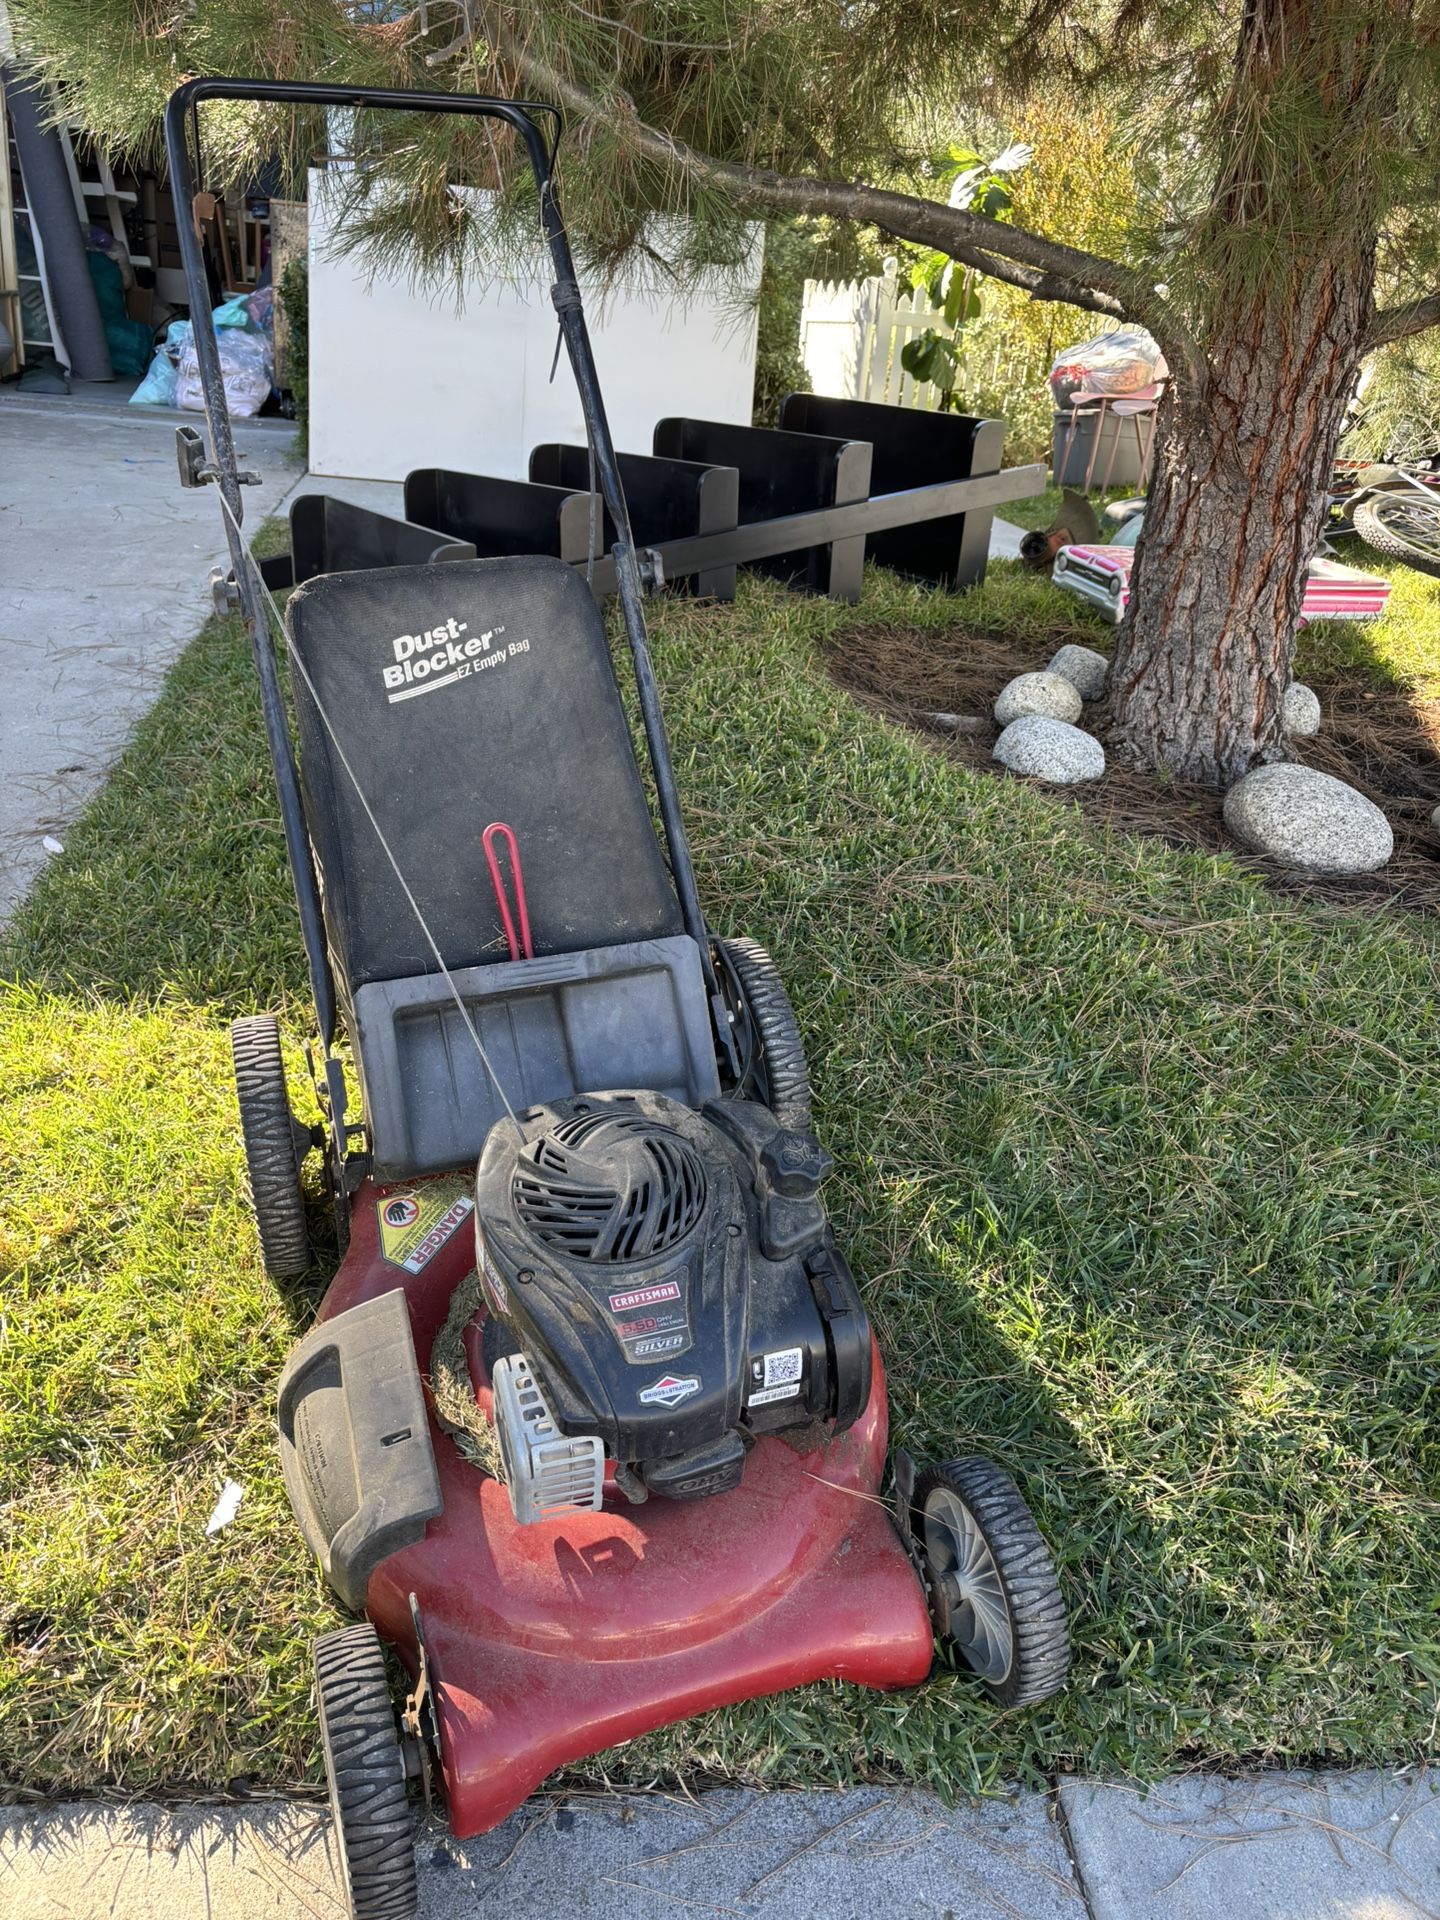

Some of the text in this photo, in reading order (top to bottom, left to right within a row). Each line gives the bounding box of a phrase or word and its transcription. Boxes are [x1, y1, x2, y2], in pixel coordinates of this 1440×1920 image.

[382, 630, 493, 688] Blocker
[392, 617, 467, 662] Dust-
[457, 638, 530, 679] EZ Empty Bag
[409, 1204, 468, 1264] DANGER
[411, 1233, 425, 1247] FEET
[614, 1286, 675, 1308] CRAFTSMAN
[643, 1389, 666, 1400] BRIGGS
[669, 1382, 696, 1393] STRATTON
